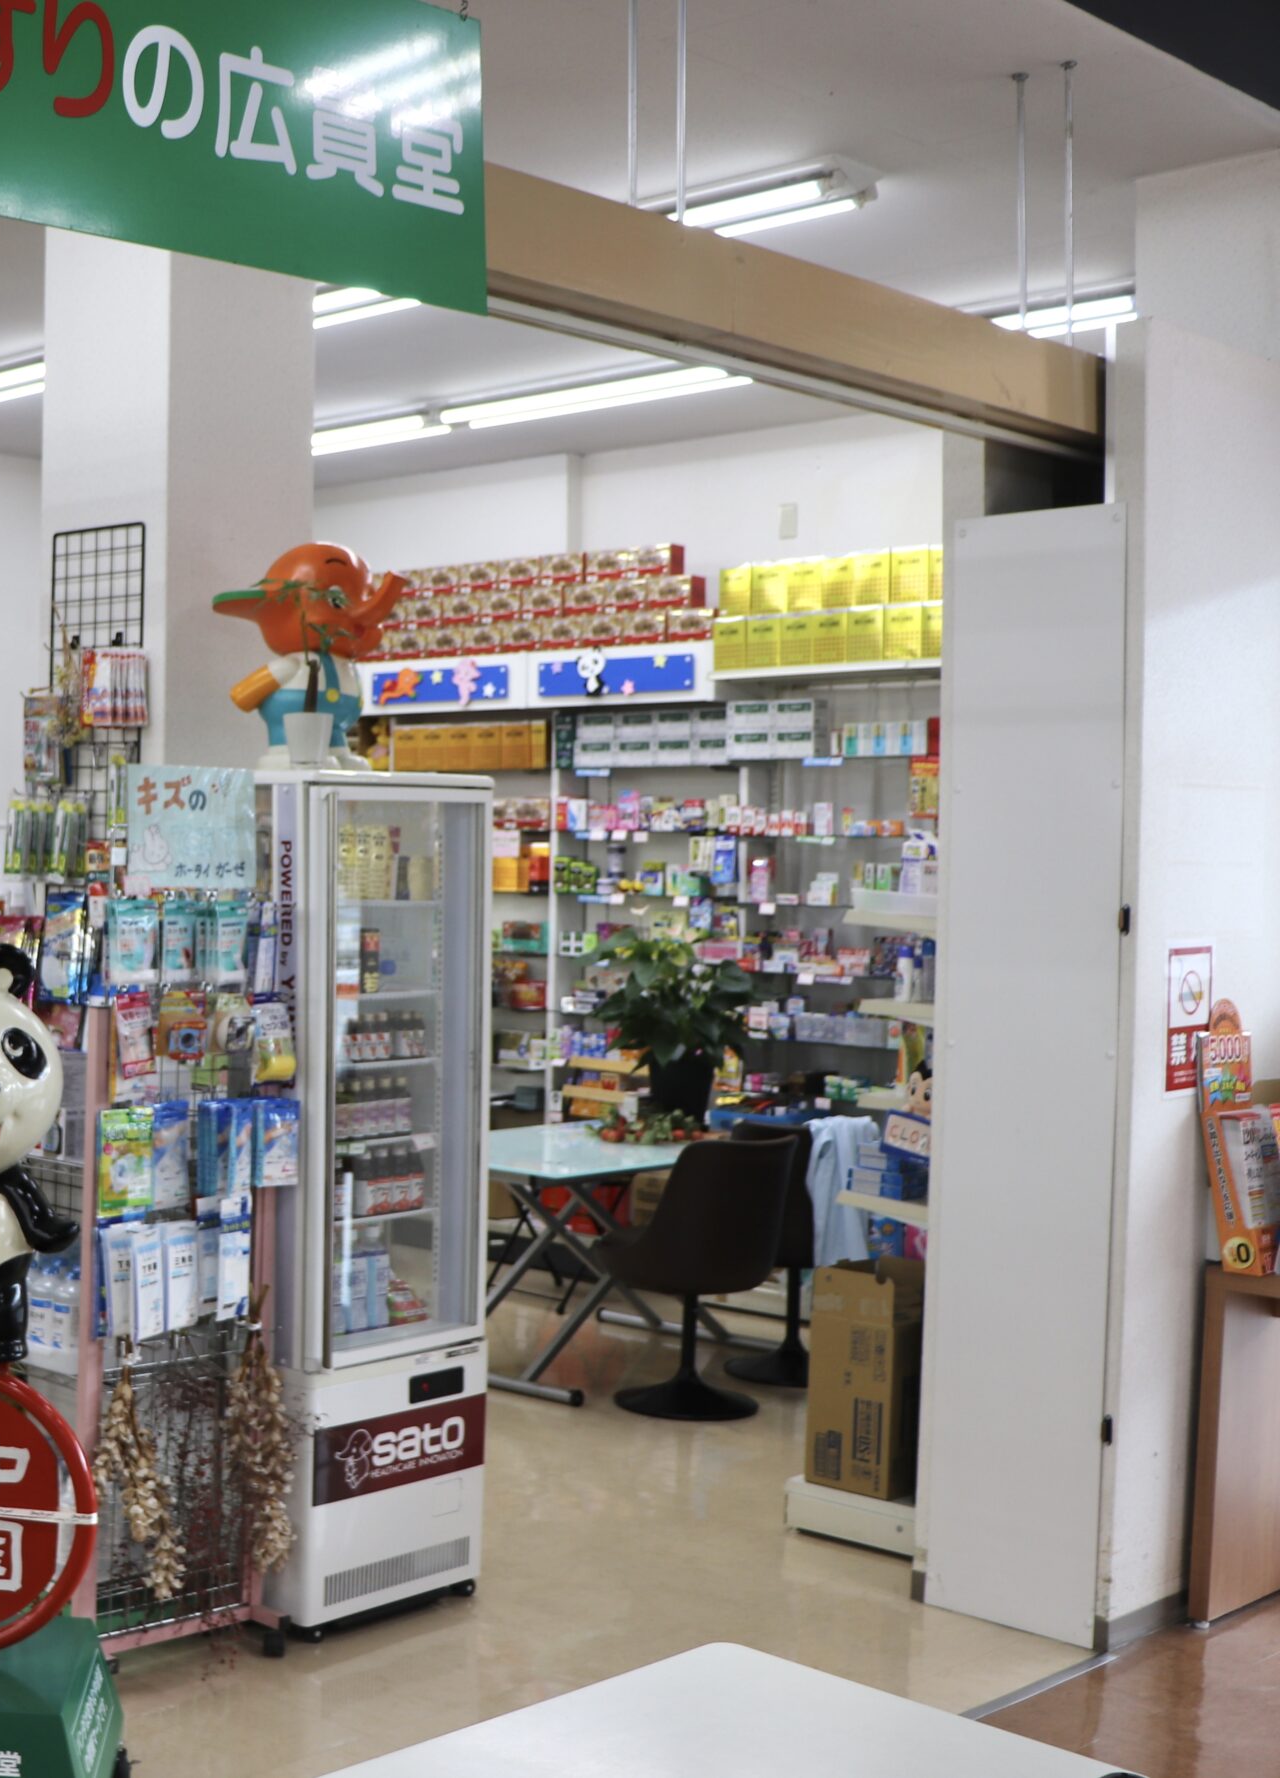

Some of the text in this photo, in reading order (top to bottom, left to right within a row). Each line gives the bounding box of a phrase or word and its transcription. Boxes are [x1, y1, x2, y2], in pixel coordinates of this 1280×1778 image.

[136, 775, 208, 816] キズの
[174, 862, 211, 879] ホータイ
[279, 840, 294, 947] POWERED
[279, 952, 289, 967] by
[372, 1416, 466, 1468] sato
[371, 1449, 464, 1479] HEALTHCARE INNOVATION
